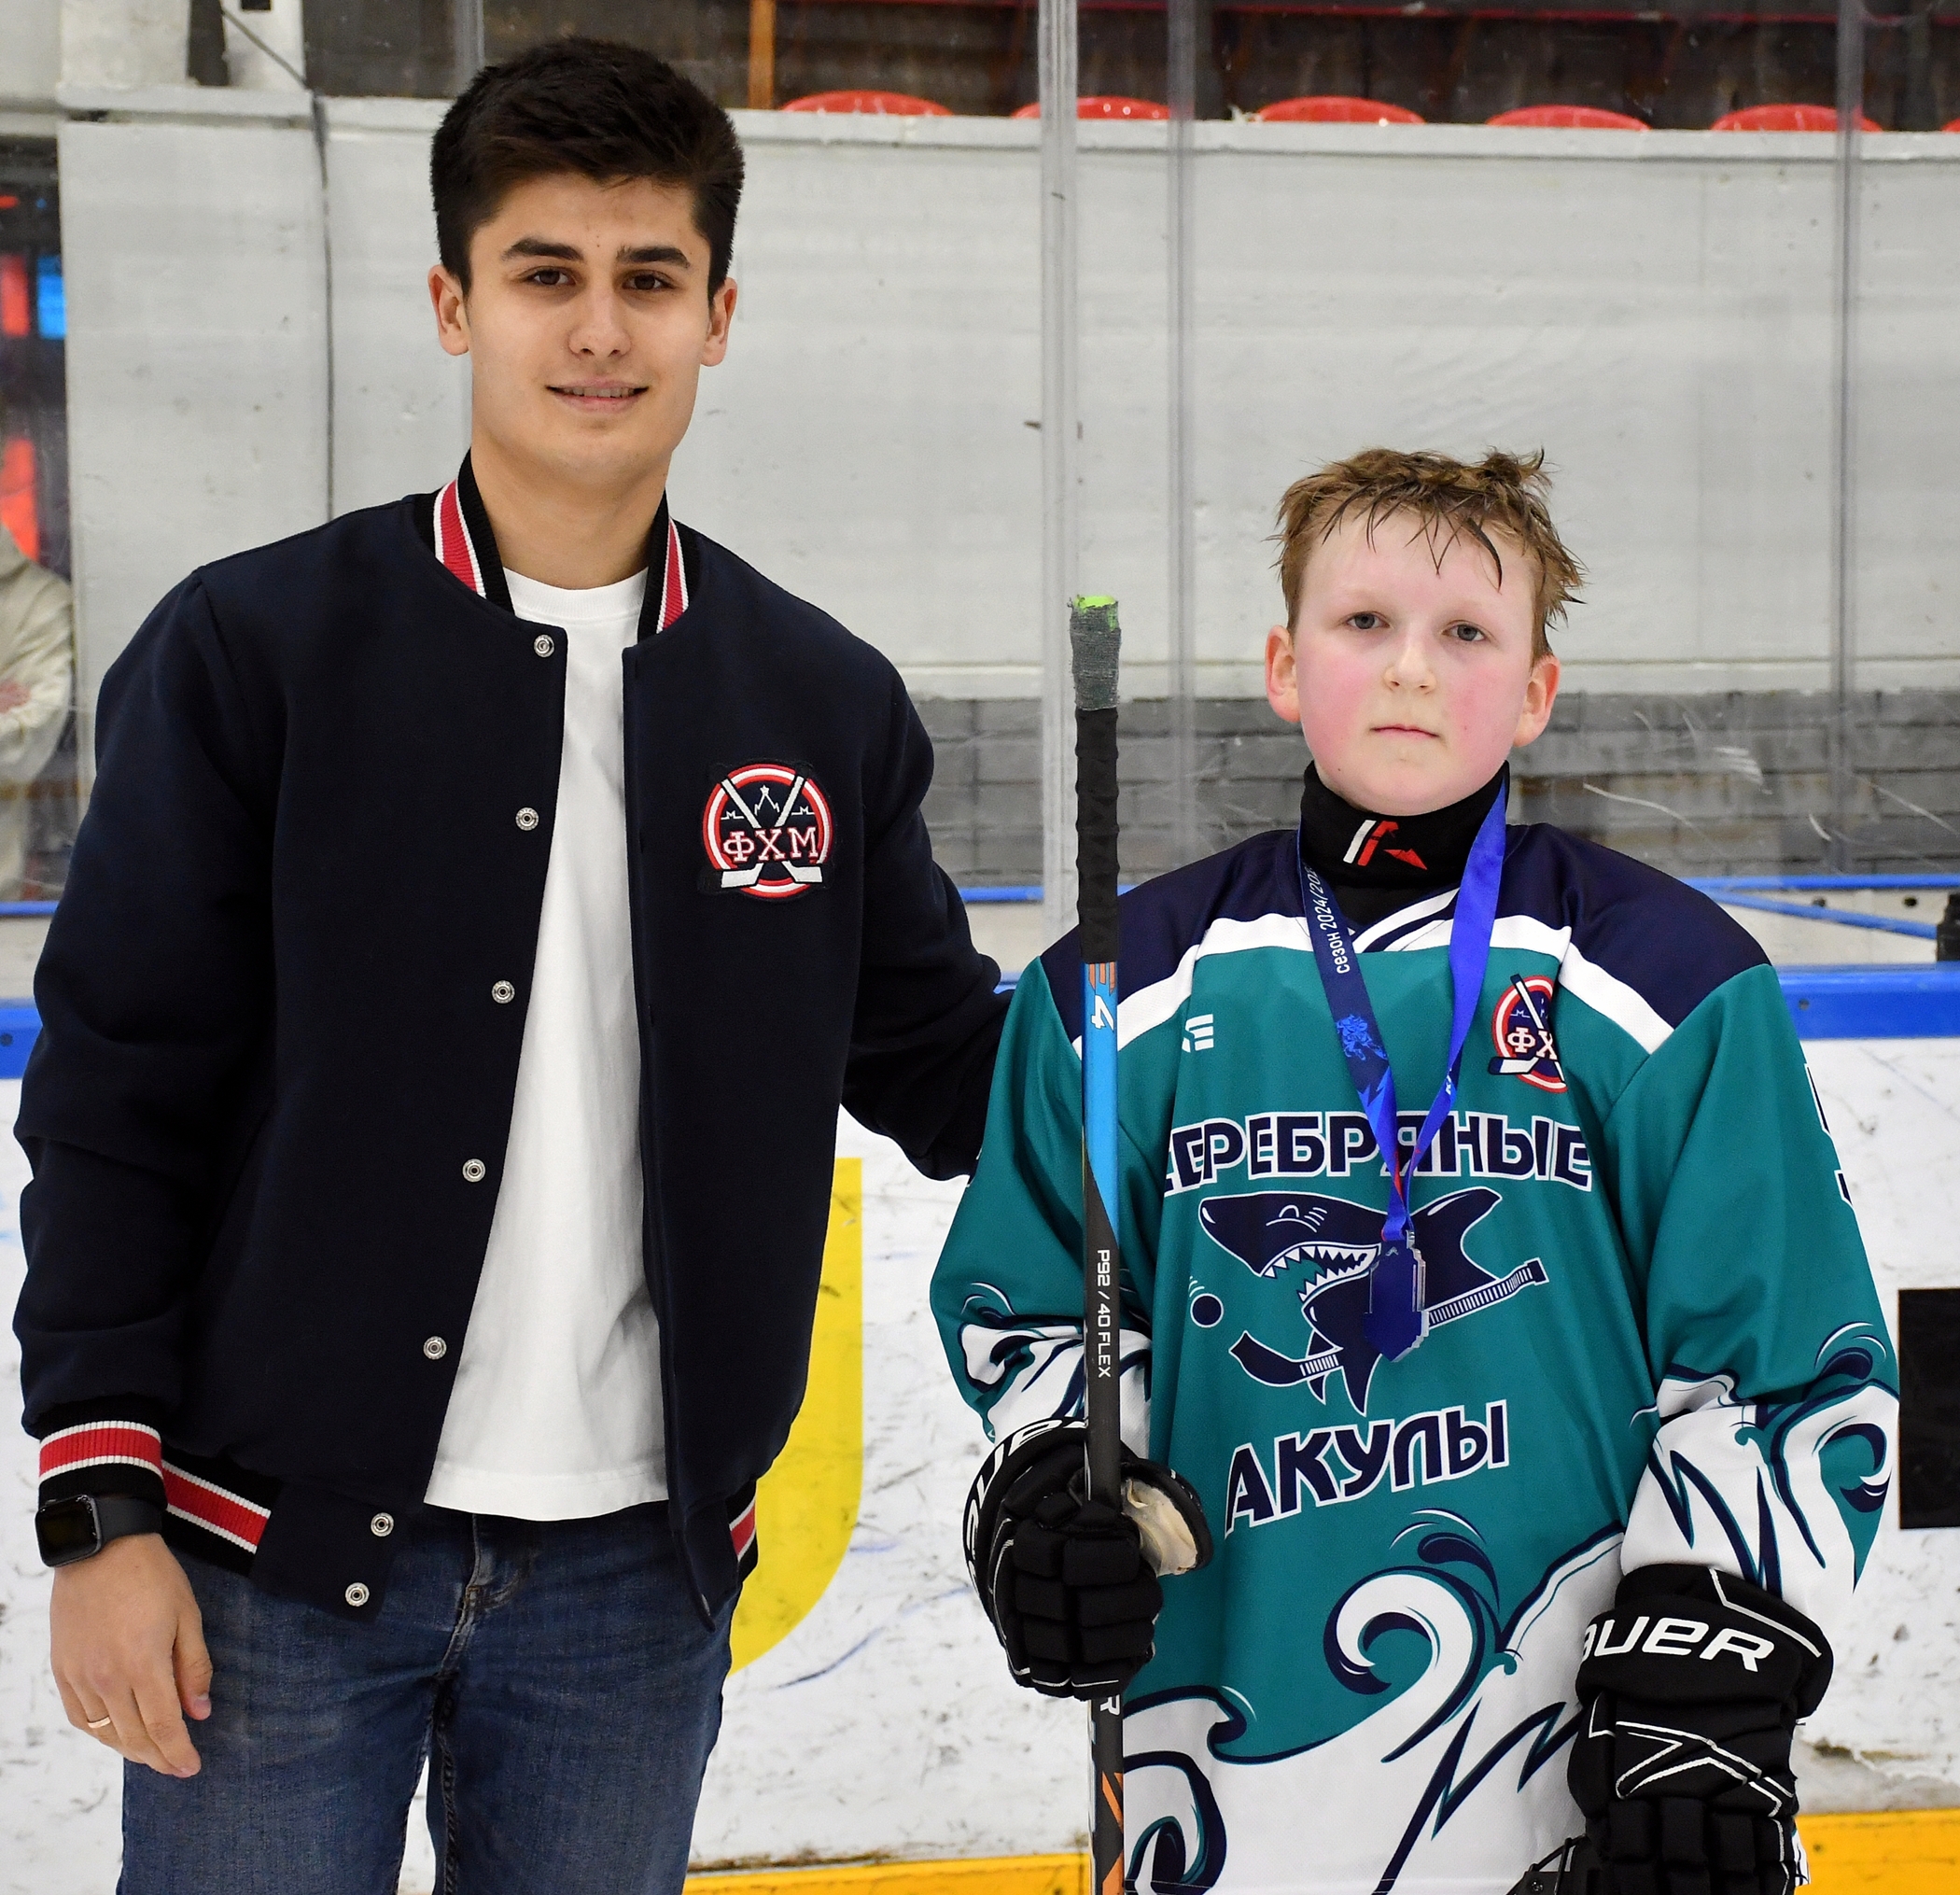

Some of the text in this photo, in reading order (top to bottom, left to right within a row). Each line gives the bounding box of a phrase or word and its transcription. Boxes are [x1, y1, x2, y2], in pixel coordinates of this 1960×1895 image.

[722, 826, 819, 863] ФХМ
[1326, 932, 1351, 974] сезон
[1506, 1026, 1558, 1060] ФХ
[1164, 1110, 1592, 1198] ЕРЕБРЯНЫЕ
[1097, 1249, 1111, 1287] P92
[1097, 1303, 1111, 1327] 40
[1098, 1331, 1111, 1378] FLEX
[1225, 1399, 1510, 1540] АКУЛЫ
